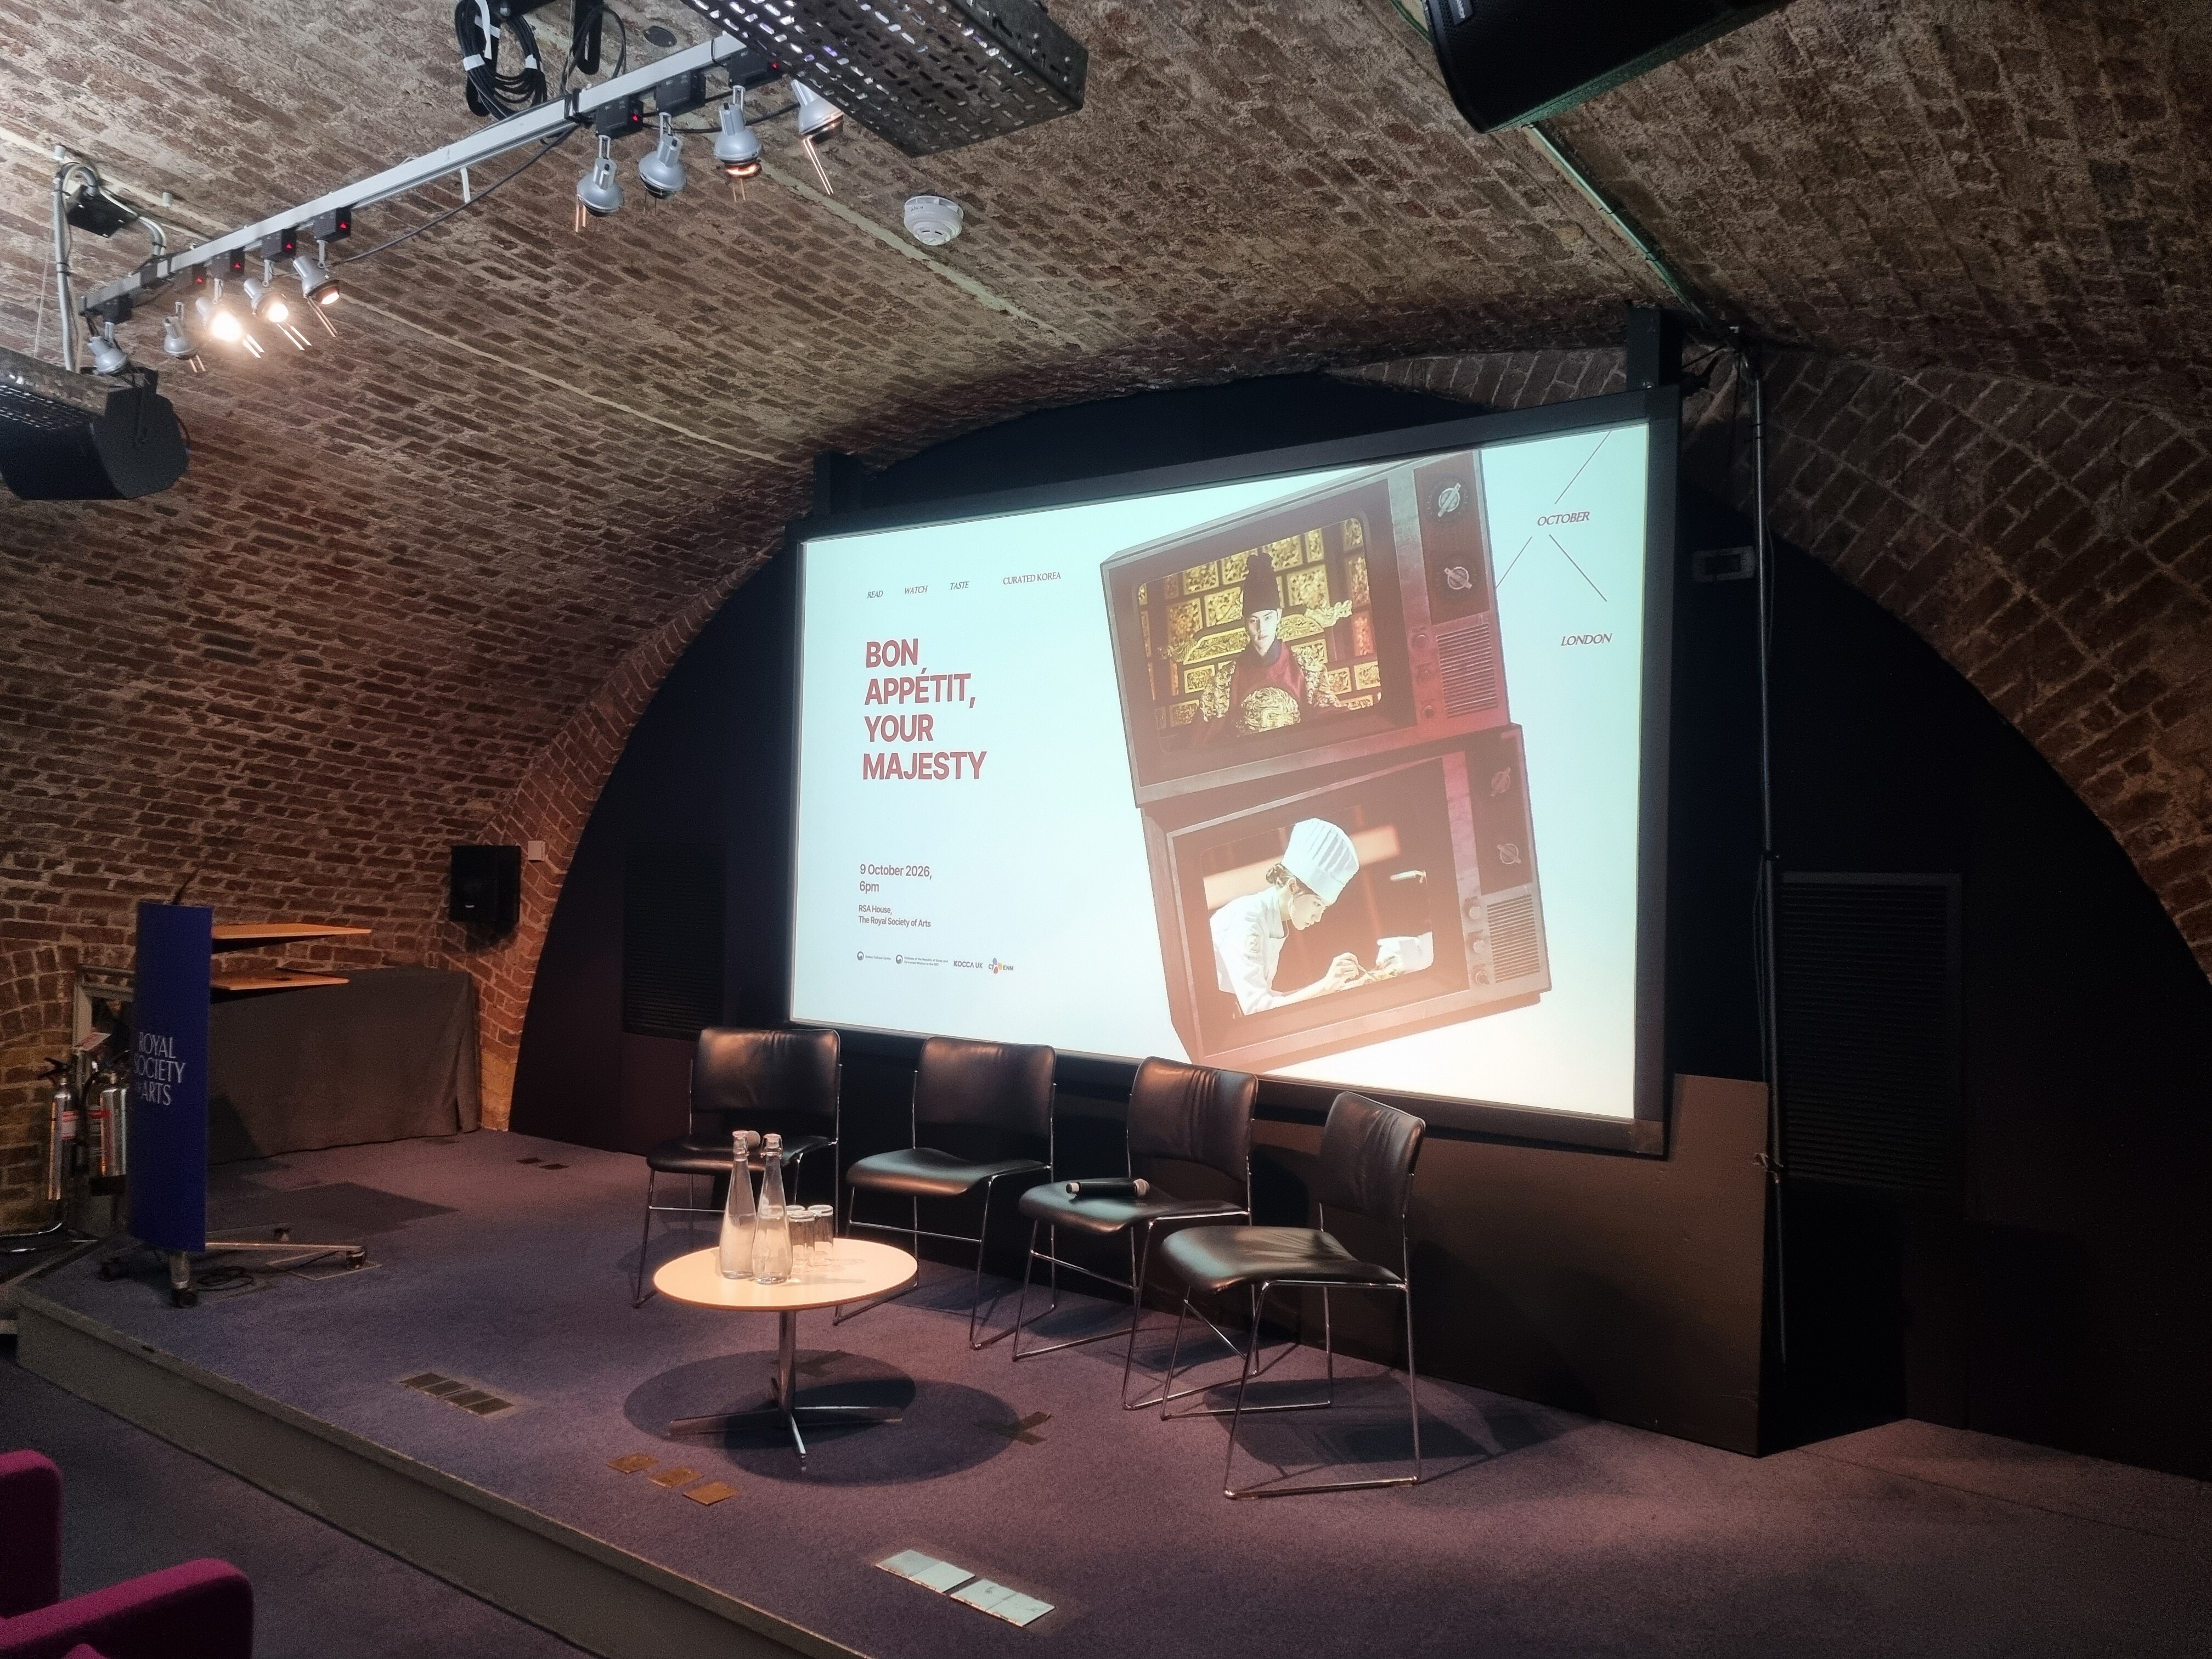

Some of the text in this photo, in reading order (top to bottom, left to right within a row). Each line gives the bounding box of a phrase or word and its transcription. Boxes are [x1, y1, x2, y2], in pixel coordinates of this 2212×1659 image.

[1538, 511, 1590, 526] OCTOBER
[950, 581, 969, 590] TASTE
[1003, 572, 1061, 585] CURATED KOREA
[867, 590, 883, 599] READ
[904, 585, 928, 595] WATCH
[1561, 633, 1613, 646] LONDON
[866, 638, 918, 668] BON
[864, 668, 975, 709] APPÉTIT,
[864, 714, 934, 742] YOUR
[863, 751, 987, 780] MAJESTY
[860, 864, 932, 880] 9 October 2026,
[859, 881, 879, 894] 6pm
[859, 904, 892, 916] RSA House,
[858, 915, 931, 928] The Royal Society of Arts
[953, 960, 974, 968] KOCCA
[139, 1031, 177, 1059] ROYAL
[134, 1053, 187, 1084] SOCIETY
[141, 1080, 172, 1105] ARTS
